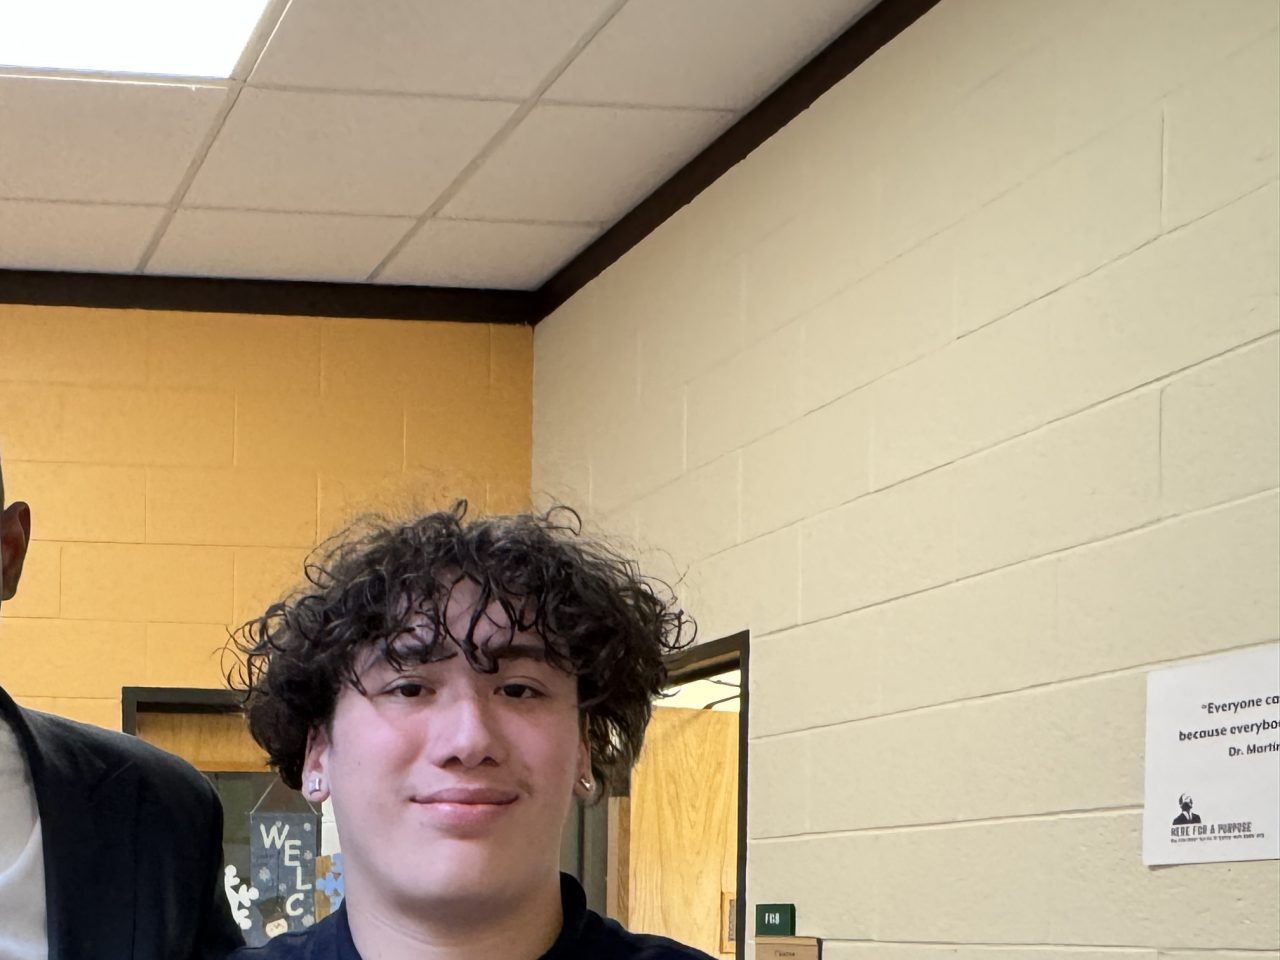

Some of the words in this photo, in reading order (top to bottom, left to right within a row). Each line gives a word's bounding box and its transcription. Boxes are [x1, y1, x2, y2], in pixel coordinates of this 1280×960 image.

[1201, 697, 1262, 714] "Everyone
[1179, 726, 1227, 741] because
[1230, 719, 1280, 735] everybo
[1228, 746, 1244, 757] Dr.
[1210, 824, 1216, 834] A
[1218, 821, 1252, 834] PURPOSE
